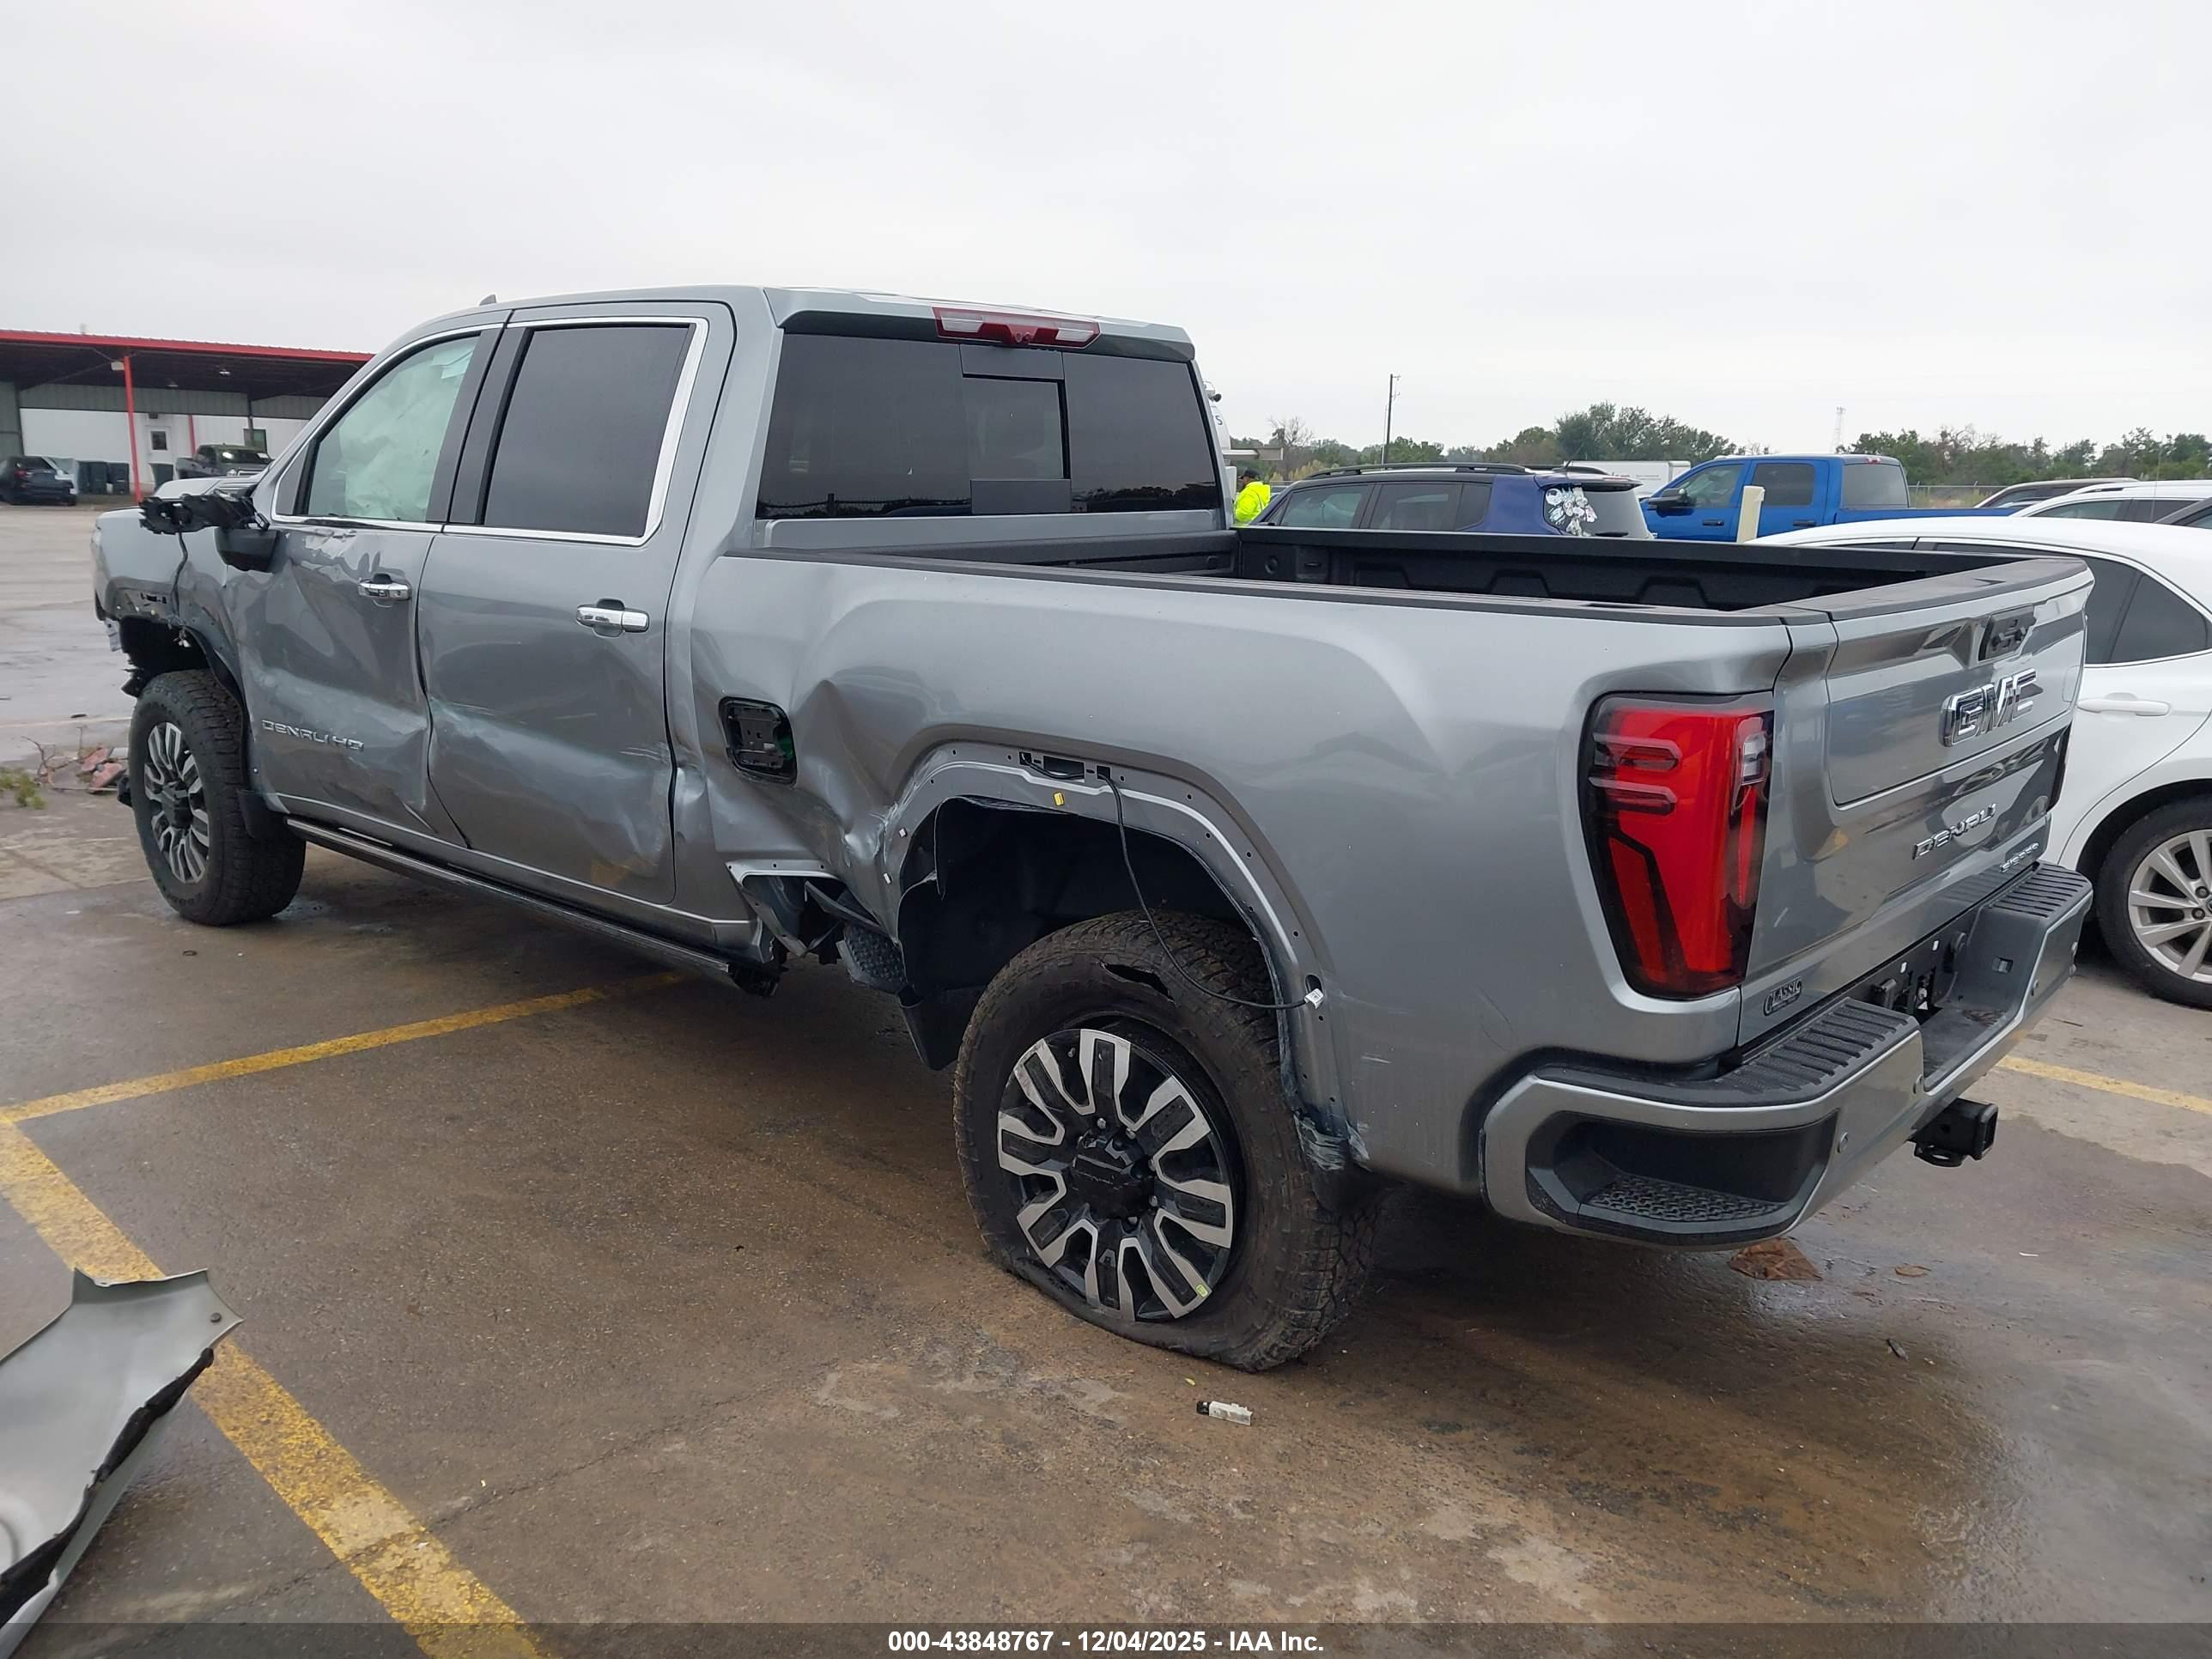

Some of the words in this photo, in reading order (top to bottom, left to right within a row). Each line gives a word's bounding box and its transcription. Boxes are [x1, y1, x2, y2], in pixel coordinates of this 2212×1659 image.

[261, 720, 329, 744] DENALI
[1939, 667, 2037, 747] GMC
[1911, 803, 1996, 860] DENALI
